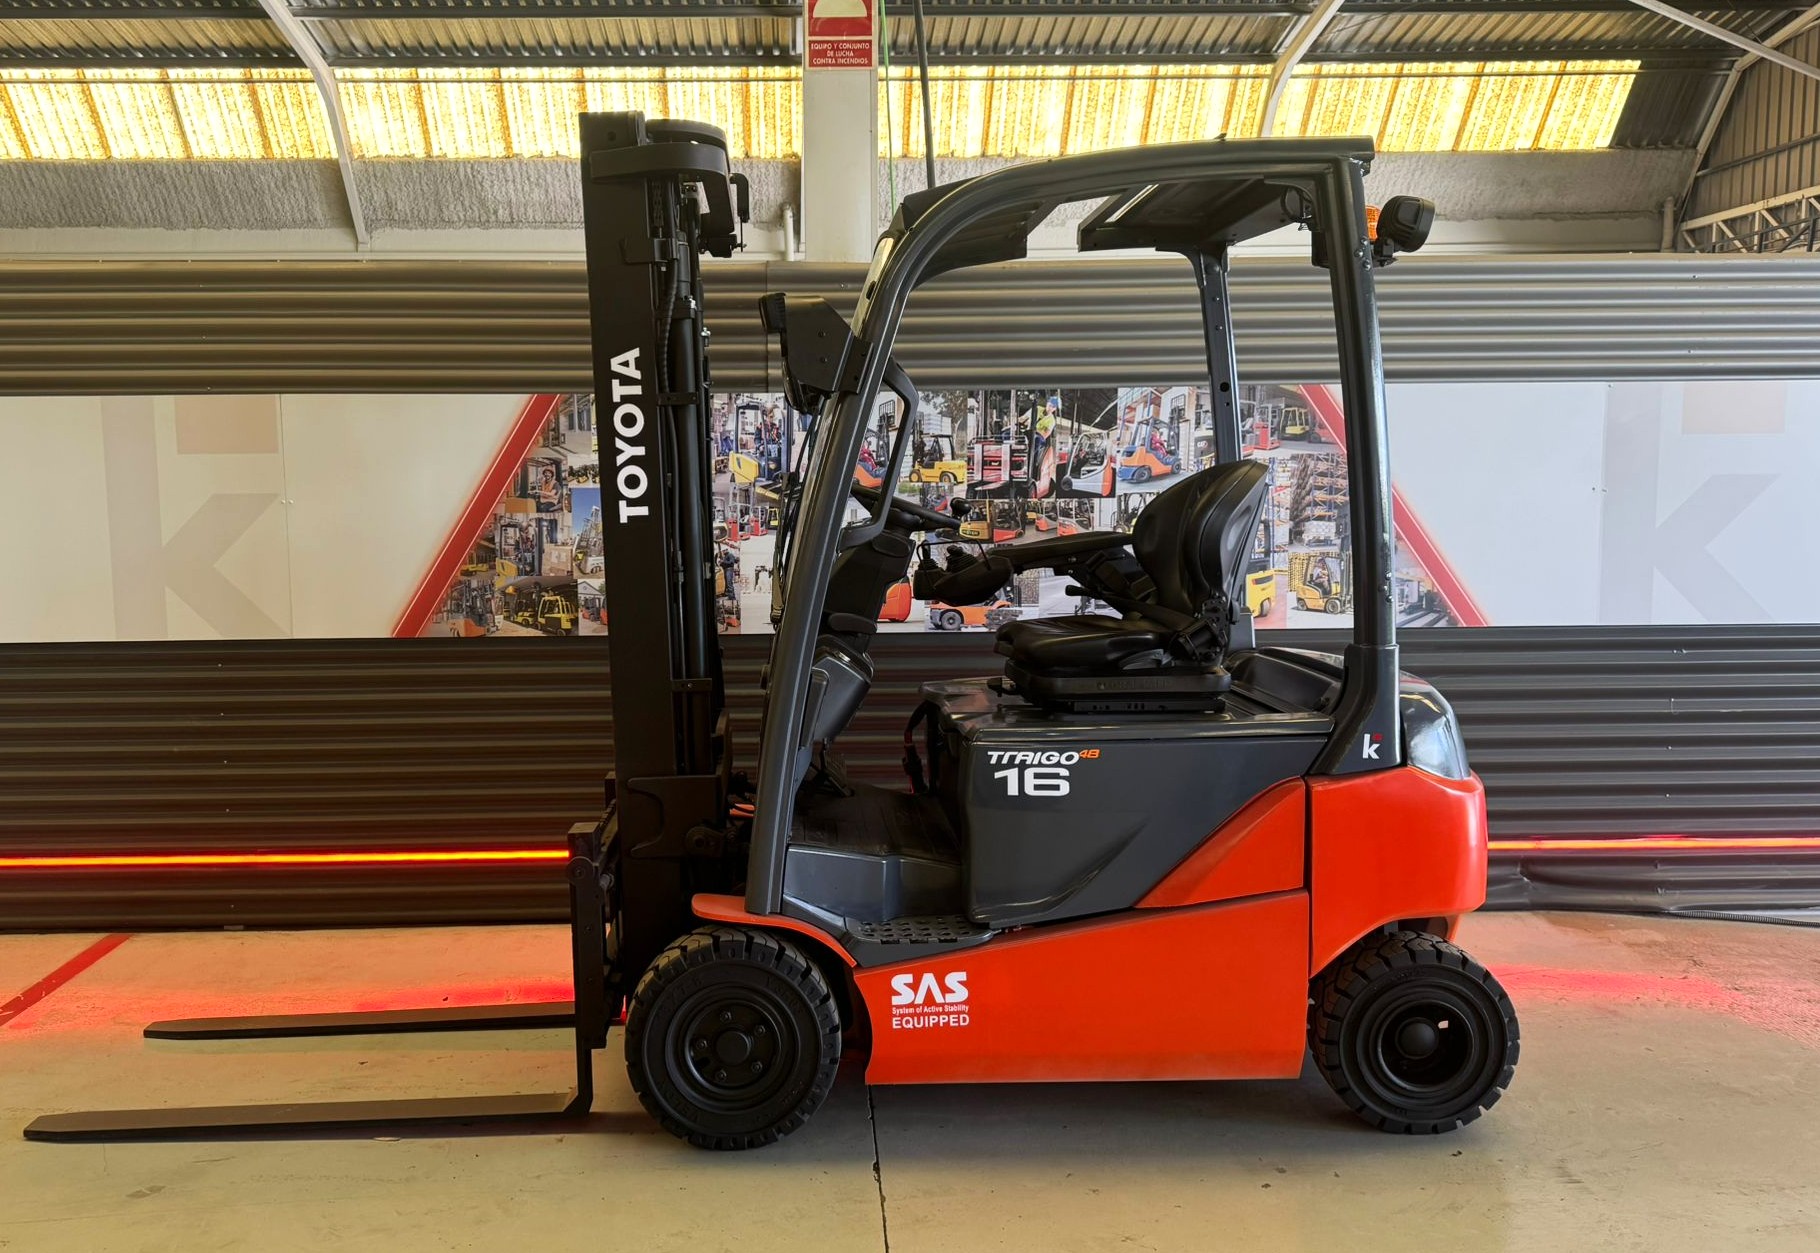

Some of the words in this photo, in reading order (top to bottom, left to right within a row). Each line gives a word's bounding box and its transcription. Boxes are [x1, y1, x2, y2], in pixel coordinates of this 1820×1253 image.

[610, 347, 650, 524] TOYOTA
[994, 767, 1070, 797] 16
[891, 971, 968, 1005] SAS
[892, 1007, 915, 1015] System
[923, 1005, 943, 1013] Active
[944, 1004, 969, 1013] Stability
[892, 1014, 970, 1029] EQUIPPED
